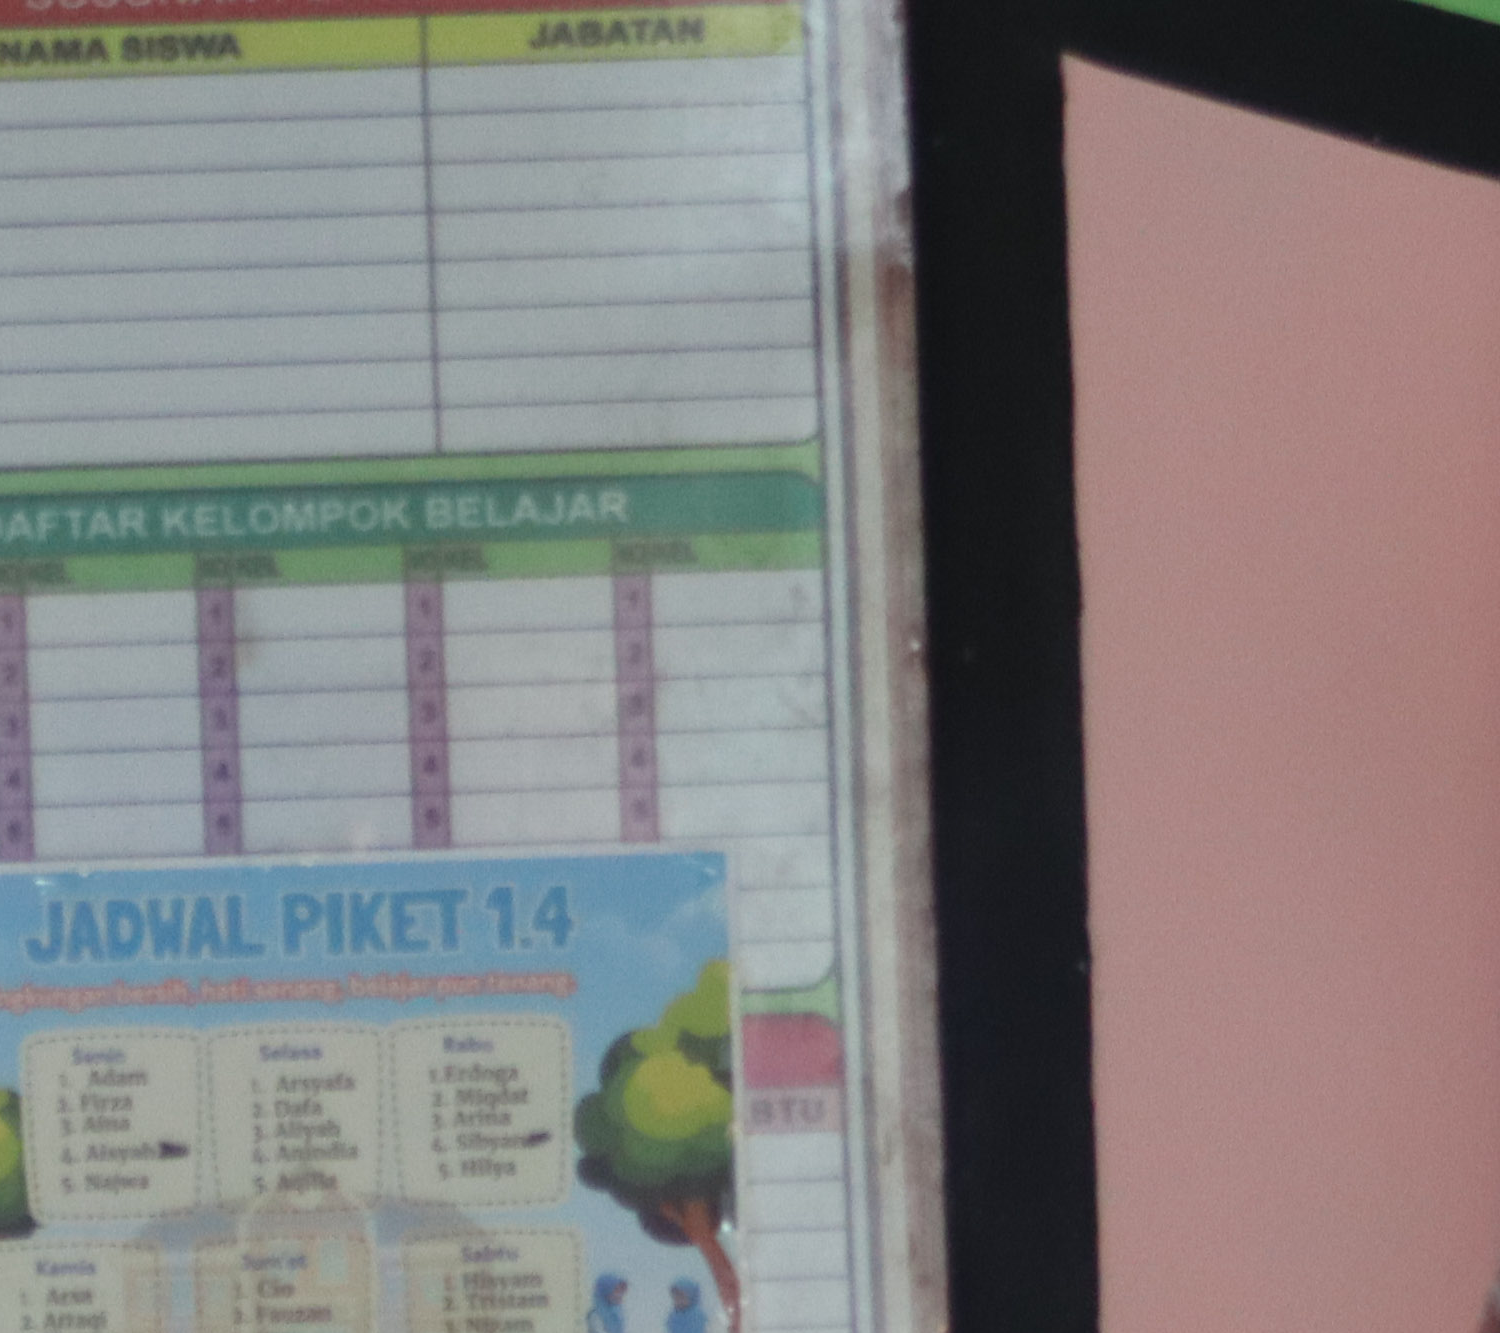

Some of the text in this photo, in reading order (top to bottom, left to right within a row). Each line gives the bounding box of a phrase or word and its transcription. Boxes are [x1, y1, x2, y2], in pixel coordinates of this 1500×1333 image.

[121, 32, 243, 63] SISWA
[528, 18, 706, 50] JABATAN
[161, 496, 412, 539] KELOMPOK
[424, 489, 630, 530] BELAJAR
[25, 884, 576, 964] JADWAL PIKET 1.4
